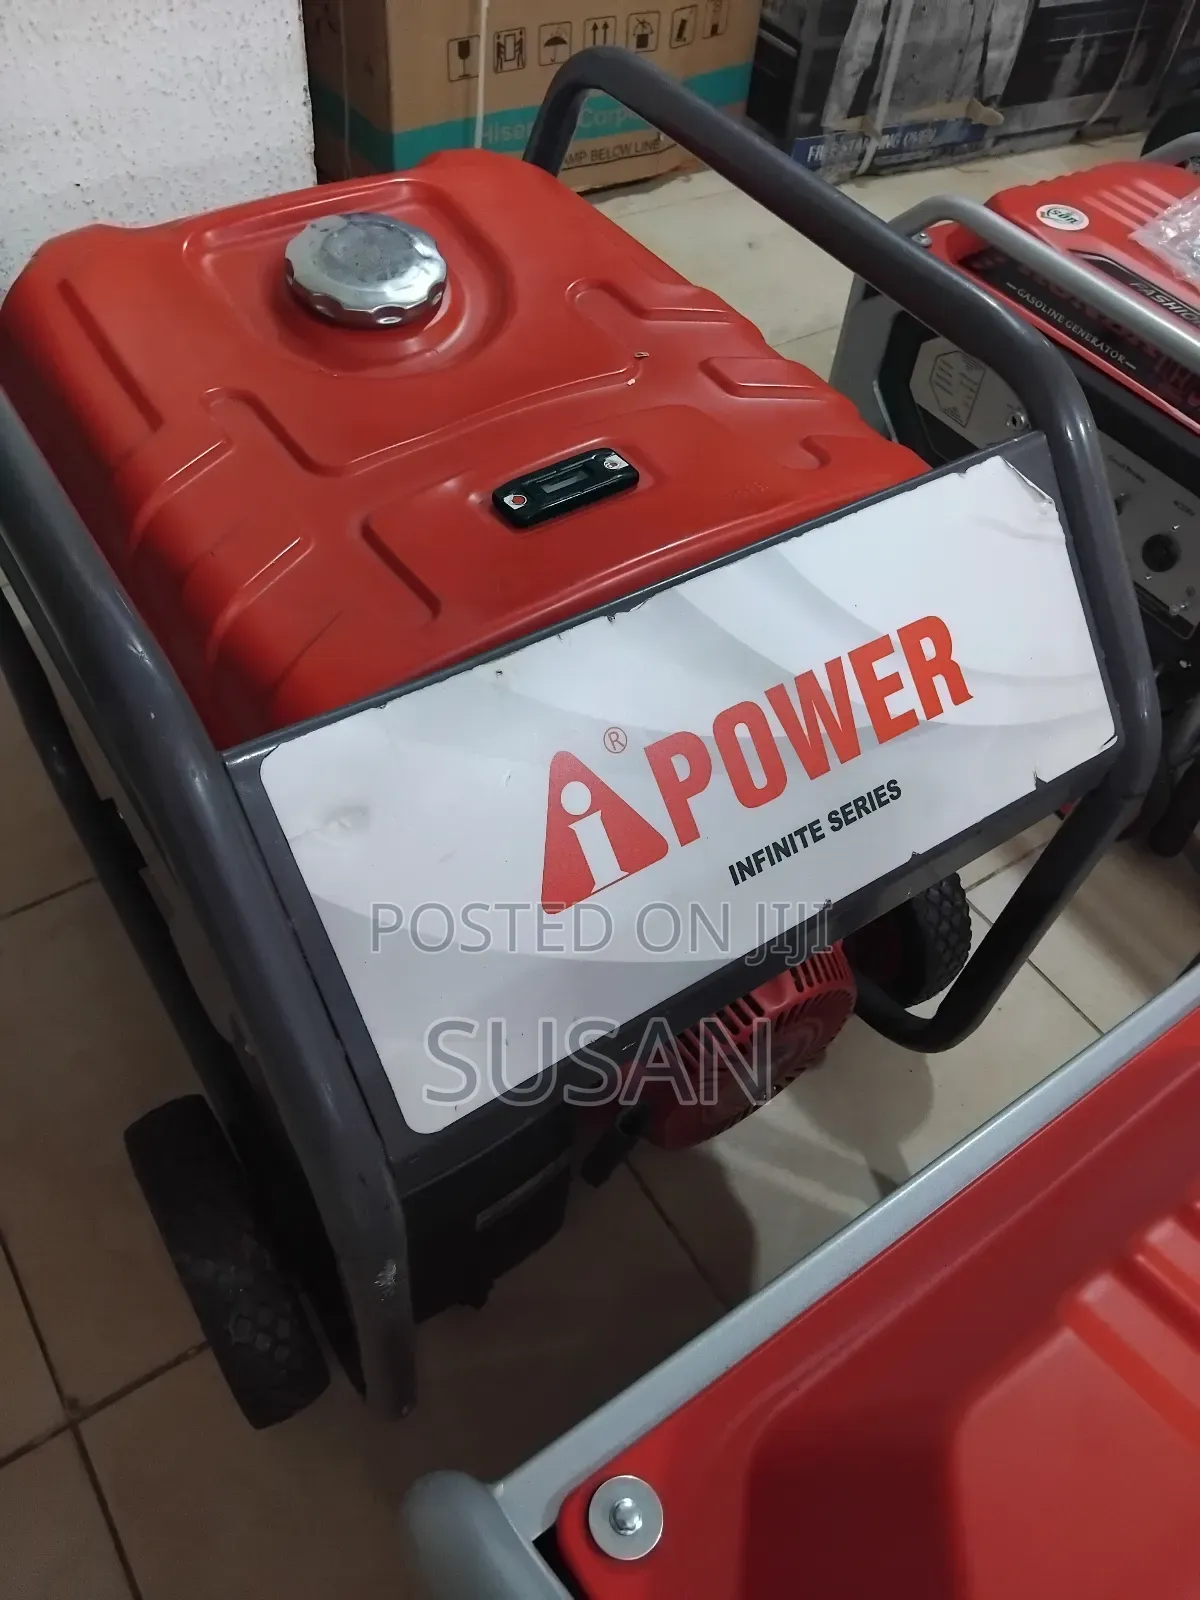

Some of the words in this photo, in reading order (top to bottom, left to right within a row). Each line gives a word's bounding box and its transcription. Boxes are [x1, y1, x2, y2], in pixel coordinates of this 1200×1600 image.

[591, 144, 632, 161] BELOW
[635, 139, 660, 153] LINE
[1017, 288, 1064, 326] GASOLINE
[1066, 322, 1127, 366] GENERATOR
[643, 615, 974, 847] POWER
[728, 819, 826, 886] INFINITE
[827, 779, 902, 832] SERIES
